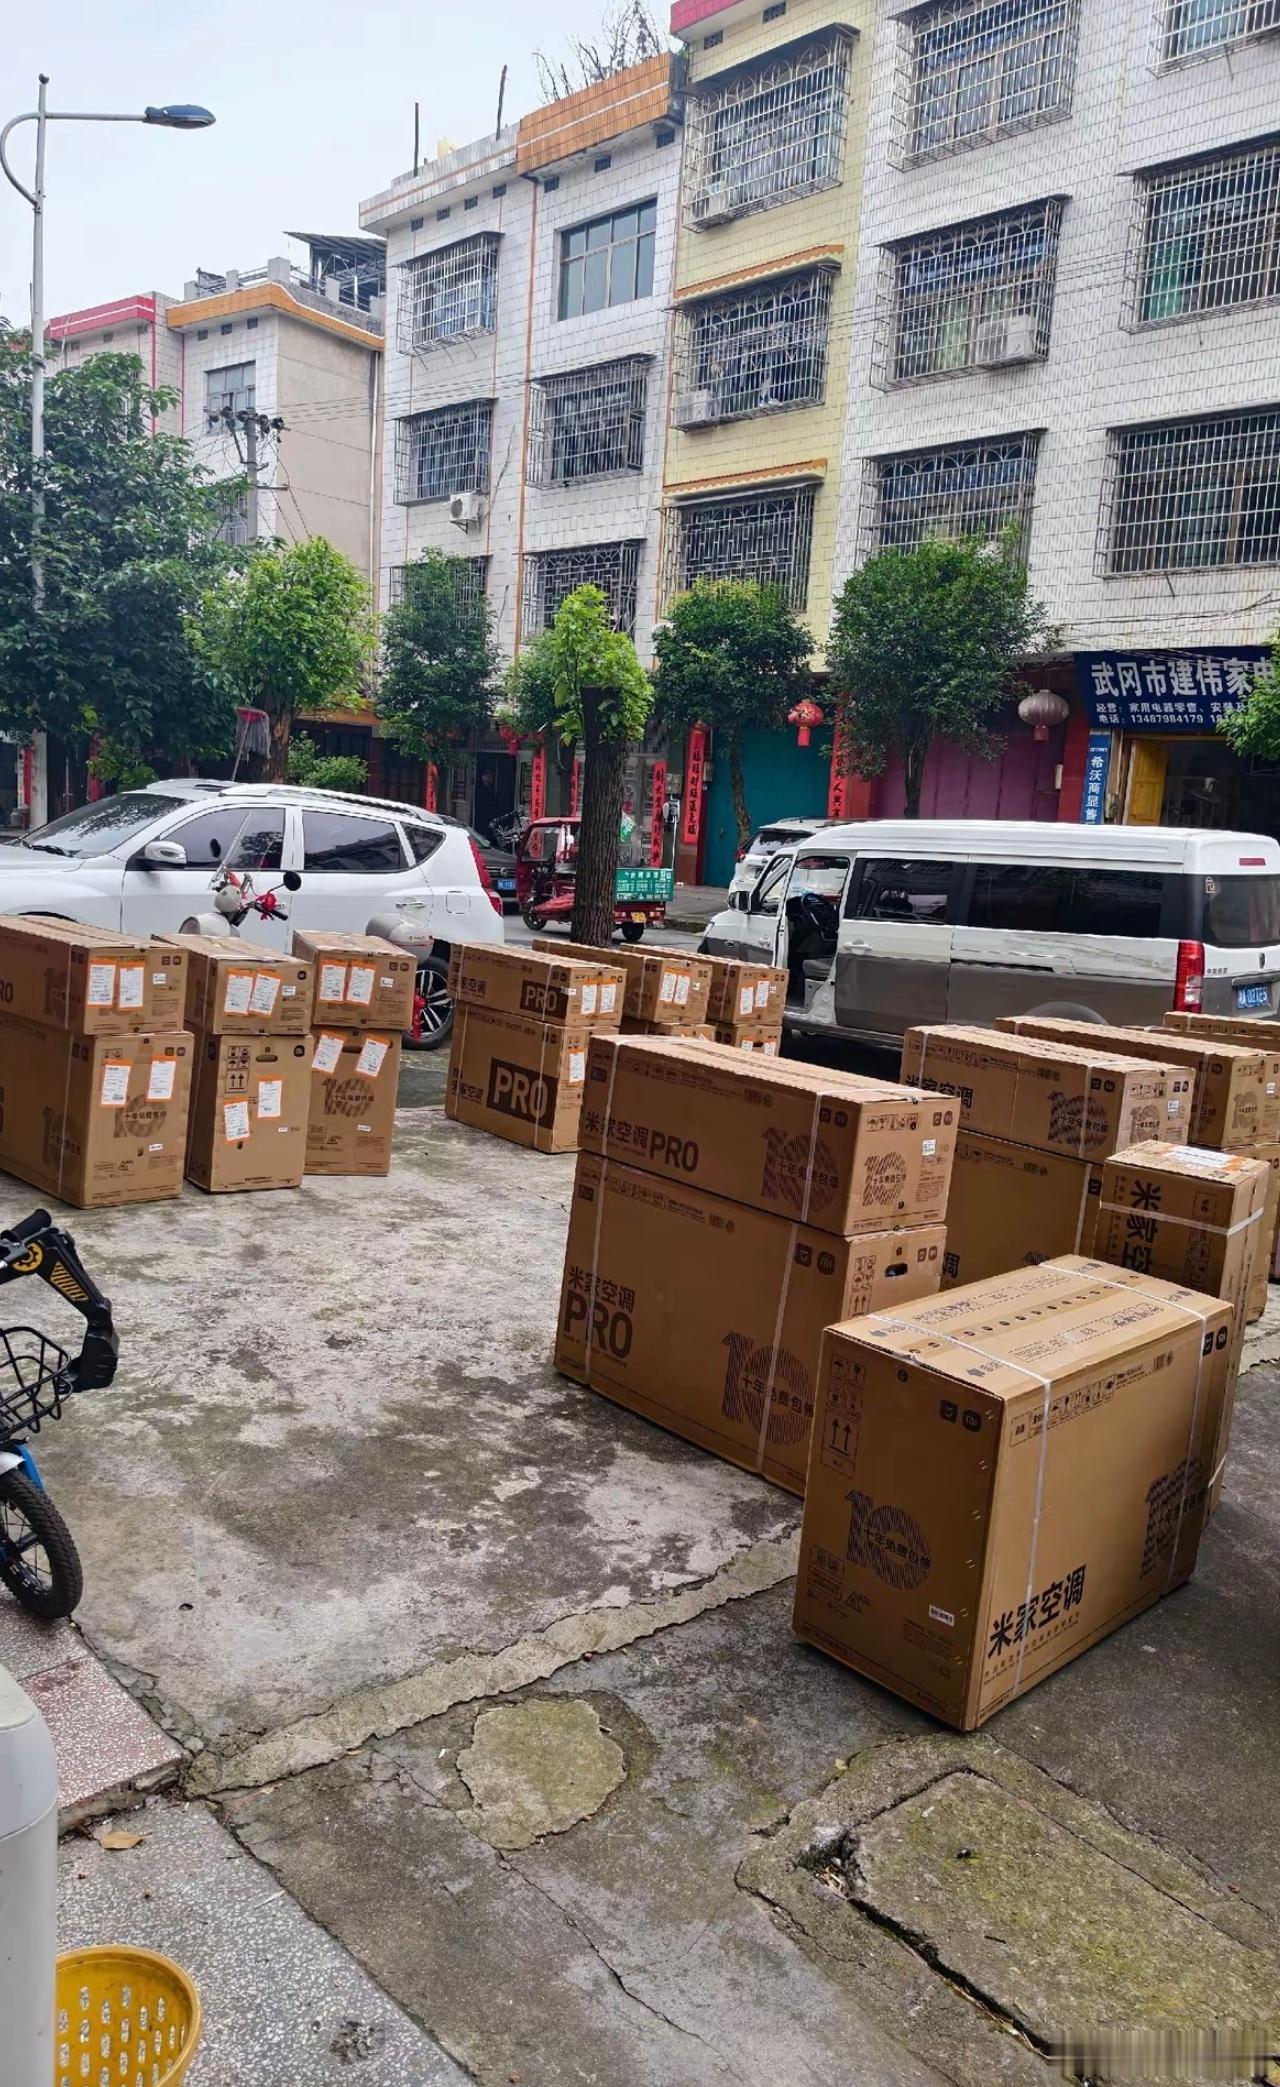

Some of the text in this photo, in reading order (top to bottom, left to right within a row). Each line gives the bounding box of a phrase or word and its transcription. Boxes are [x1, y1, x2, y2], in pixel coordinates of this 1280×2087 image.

[525, 984, 558, 1012] PRO
[493, 1066, 549, 1119] PRO
[585, 1111, 700, 1172] 米家空调 PRO
[568, 1264, 636, 1313] 米家空调
[563, 1289, 634, 1358] PRO
[988, 1563, 1088, 1659] 米家空调
